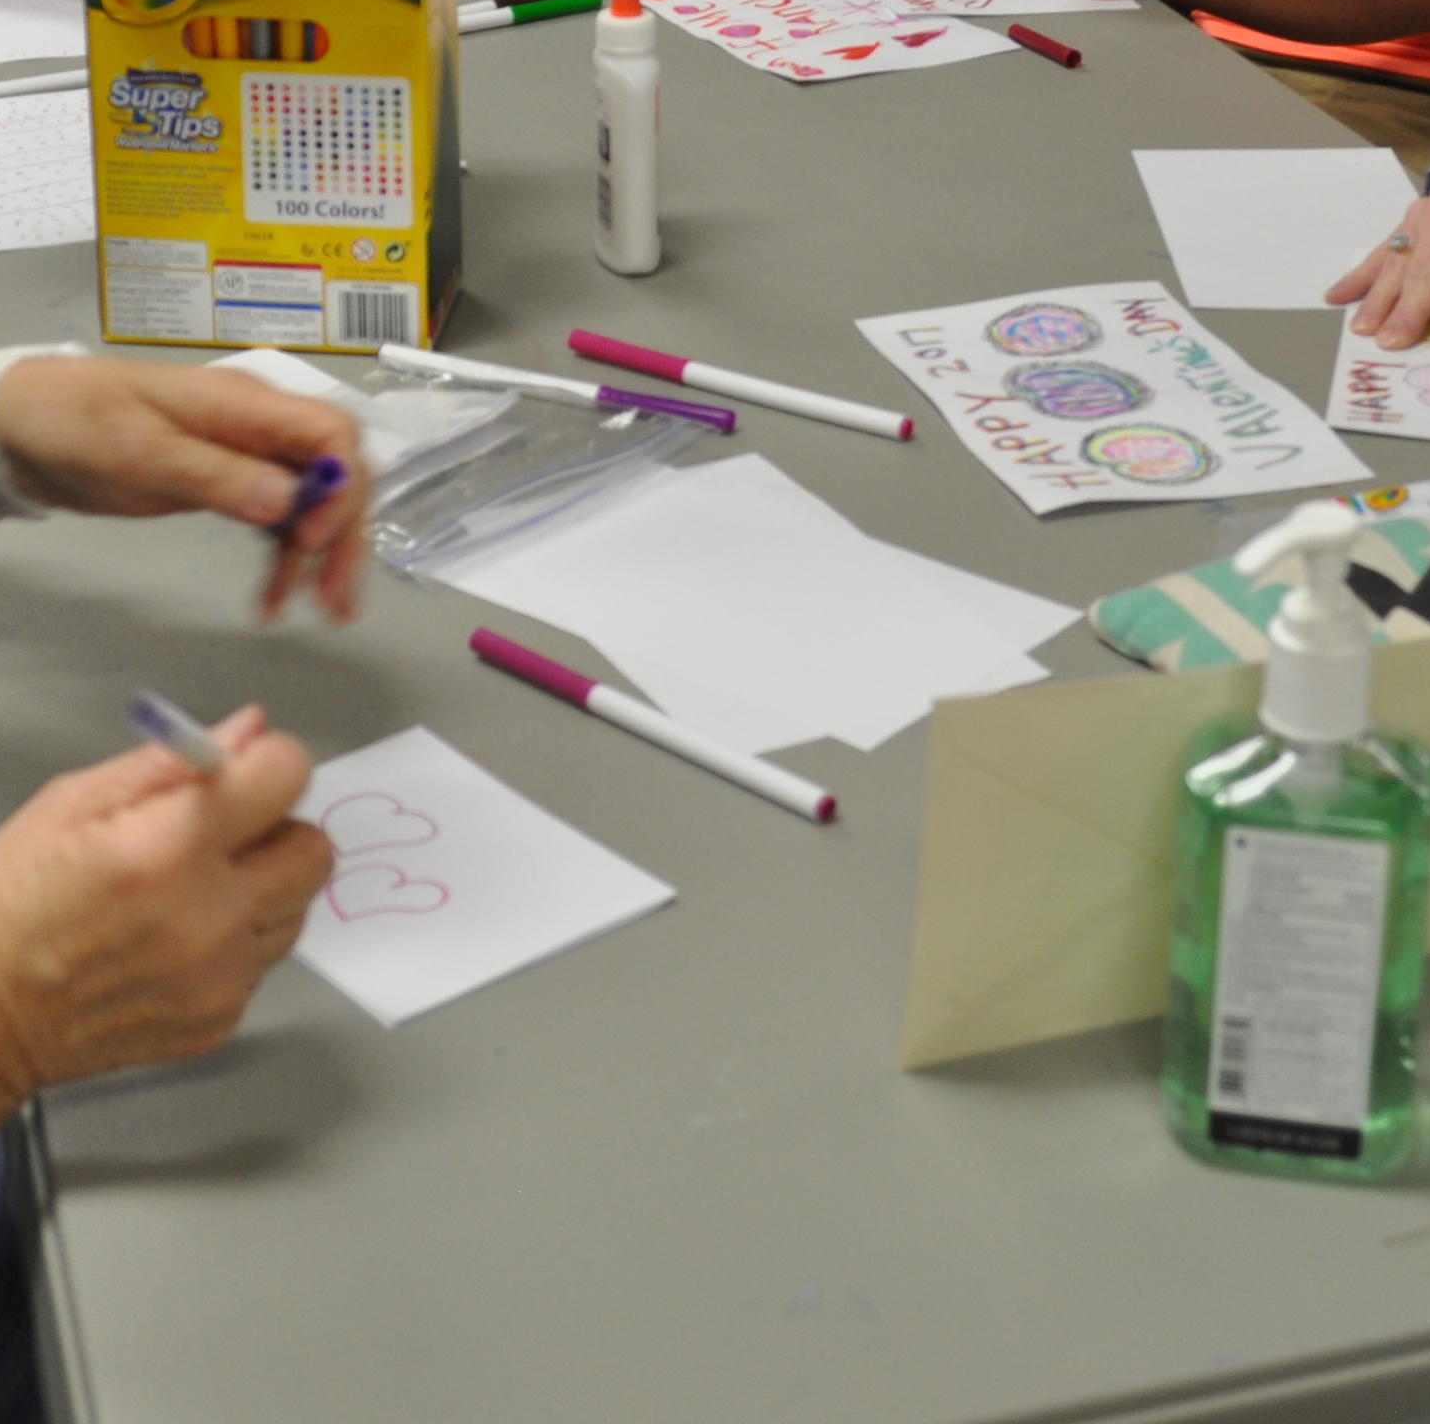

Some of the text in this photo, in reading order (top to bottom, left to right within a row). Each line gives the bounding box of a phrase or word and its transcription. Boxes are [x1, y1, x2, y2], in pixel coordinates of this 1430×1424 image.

[109, 78, 208, 112] Super
[157, 109, 221, 140] Tips
[275, 200, 386, 219] 100 Colors!
[953, 391, 1110, 489] HAPPY
